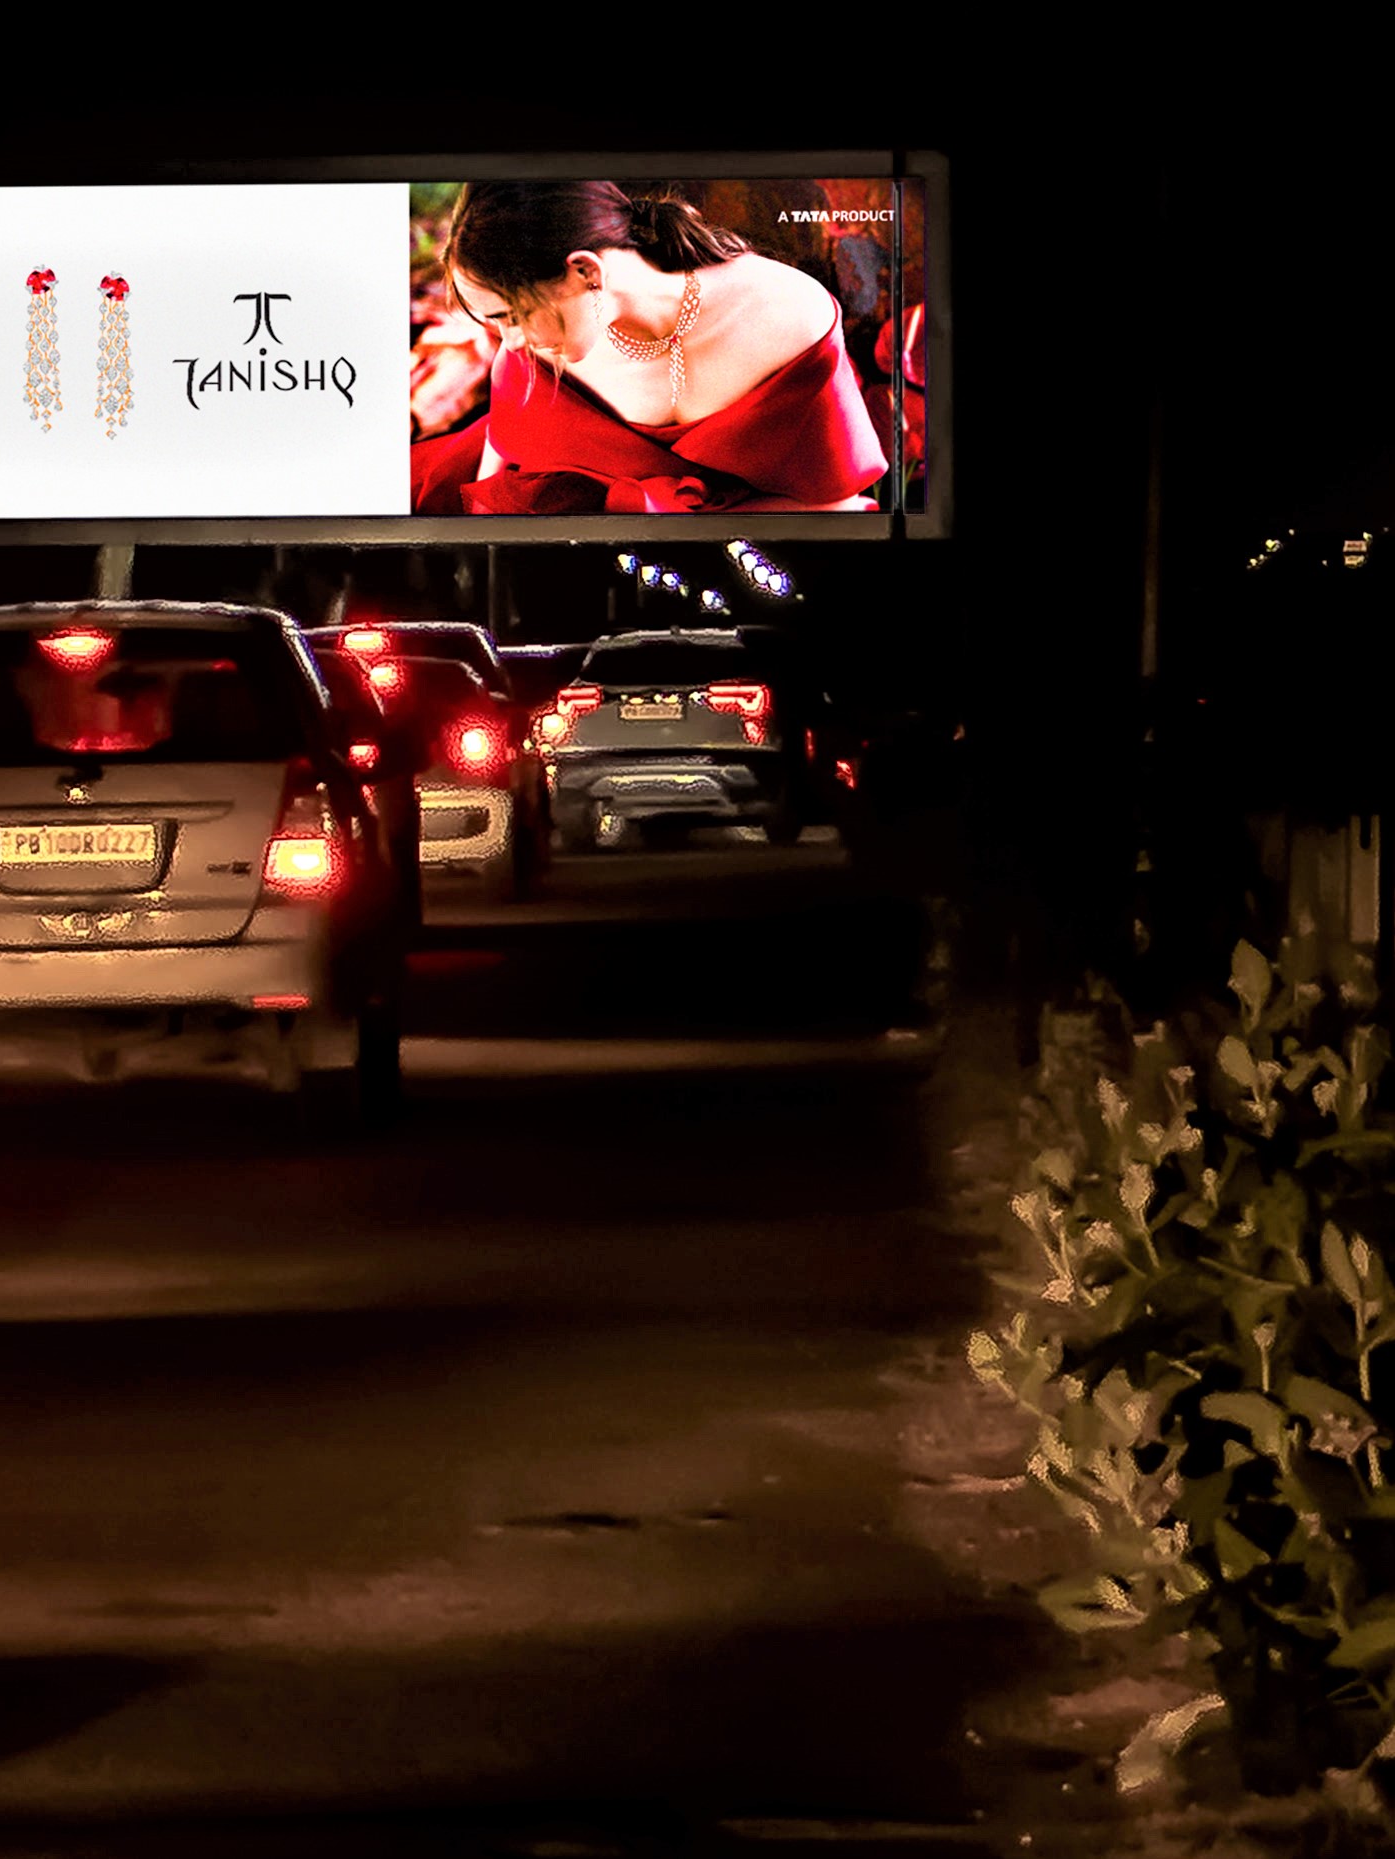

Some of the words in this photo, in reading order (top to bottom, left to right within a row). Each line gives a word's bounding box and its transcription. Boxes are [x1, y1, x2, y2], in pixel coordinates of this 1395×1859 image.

[777, 210, 789, 223] A
[791, 210, 830, 223] TATA
[831, 209, 895, 222] PRODUCT
